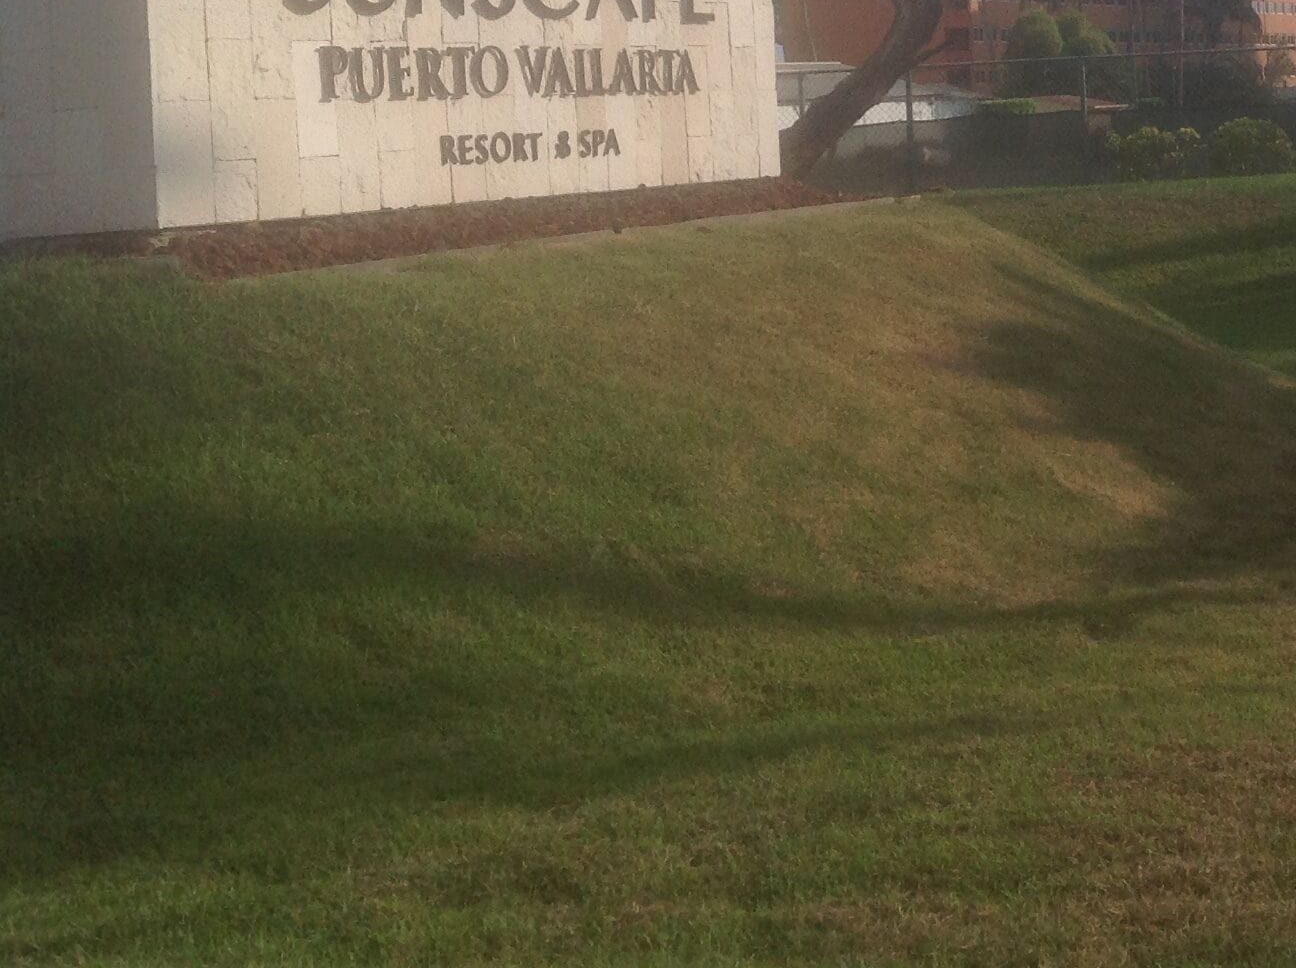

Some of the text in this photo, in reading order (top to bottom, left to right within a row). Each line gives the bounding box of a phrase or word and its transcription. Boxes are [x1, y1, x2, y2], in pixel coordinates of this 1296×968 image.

[317, 44, 701, 103] PUERTO VALLARTA
[439, 129, 621, 166] RESORT & SPA
